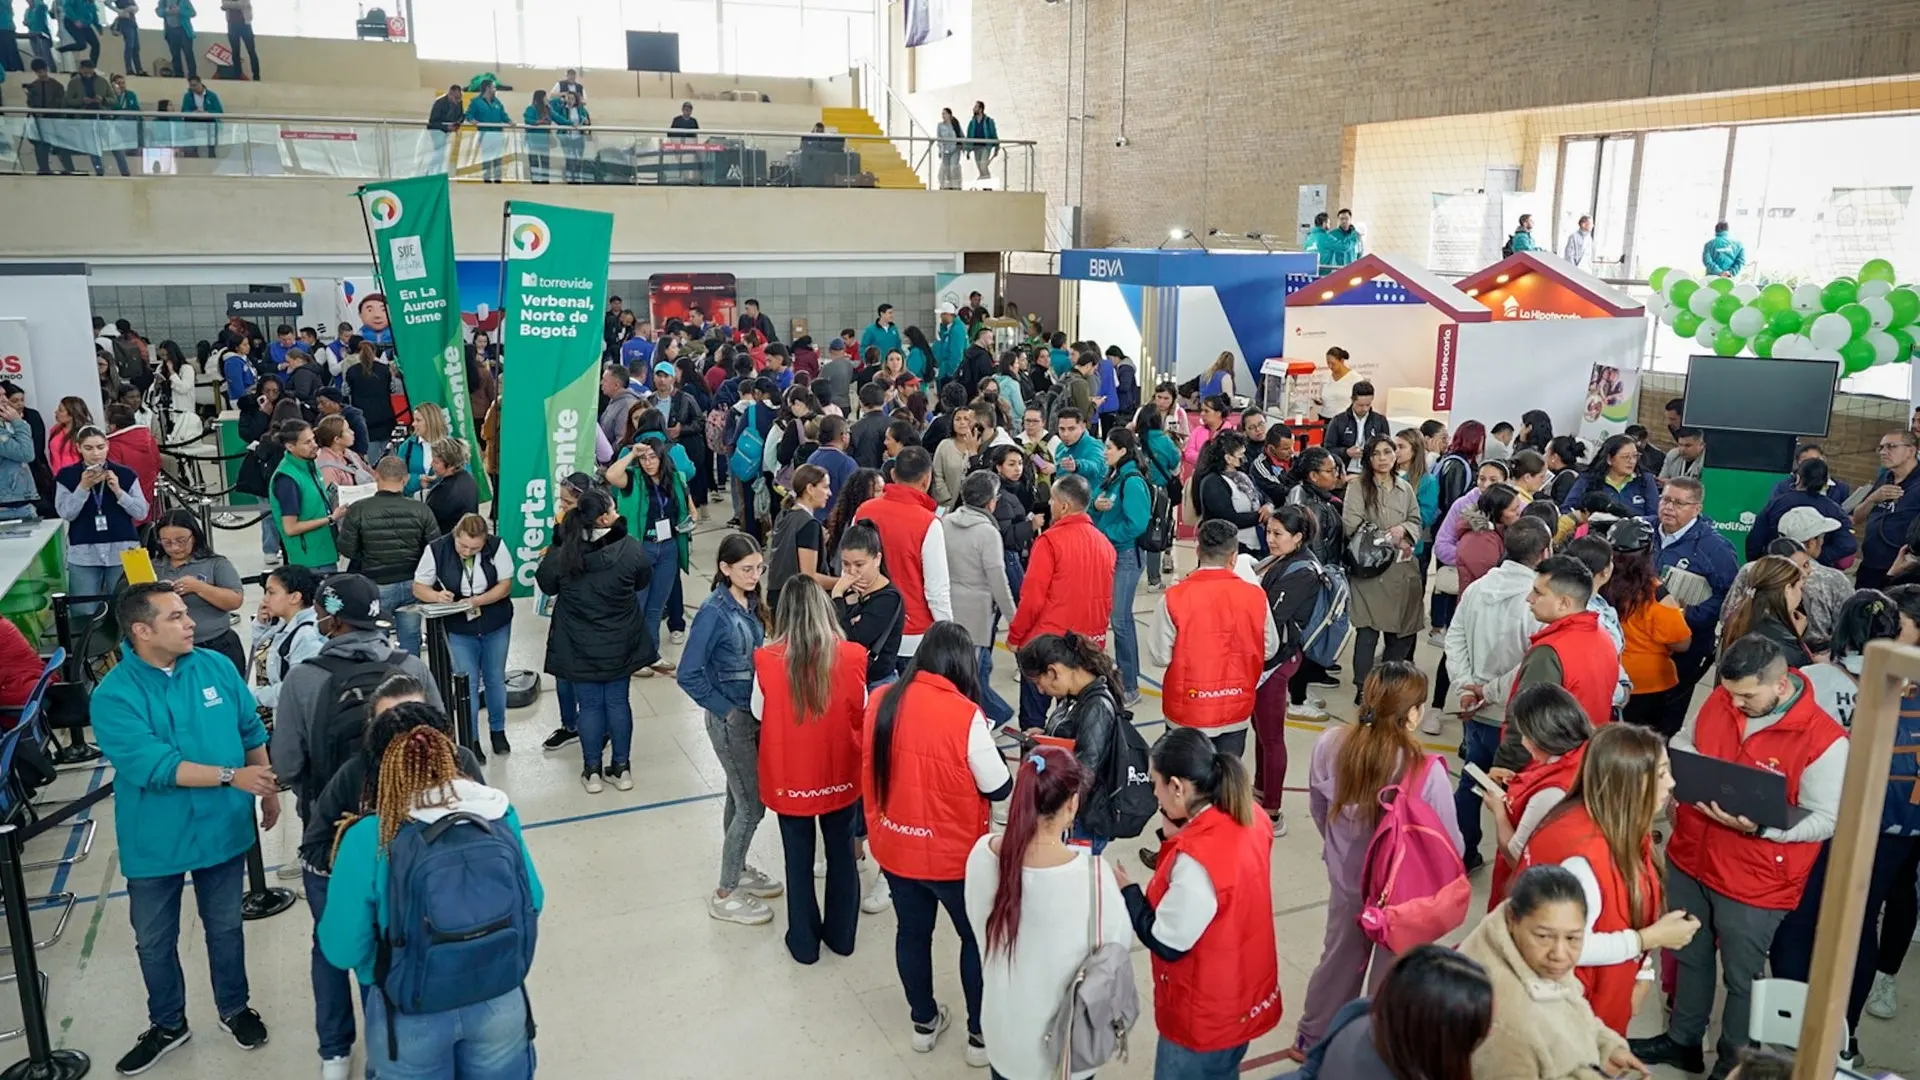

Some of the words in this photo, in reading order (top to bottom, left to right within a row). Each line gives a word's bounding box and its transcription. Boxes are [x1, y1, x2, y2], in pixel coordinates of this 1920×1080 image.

[1089, 258, 1124, 277] BBVA
[539, 277, 593, 289] torrevide
[399, 289, 418, 300] En
[420, 287, 437, 297] La
[242, 300, 297, 309] Bancolombia
[403, 298, 447, 313] Aurora
[521, 294, 594, 311] Verbenal,
[404, 312, 442, 325] Usme
[520, 308, 565, 322] Norte
[569, 311, 588, 323] de
[1519, 309, 1530, 319] La
[520, 323, 577, 338] Bogotá
[1438, 329, 1451, 393] Hipotecaria
[1438, 393, 1445, 407] La
[516, 478, 547, 587] Oferta
